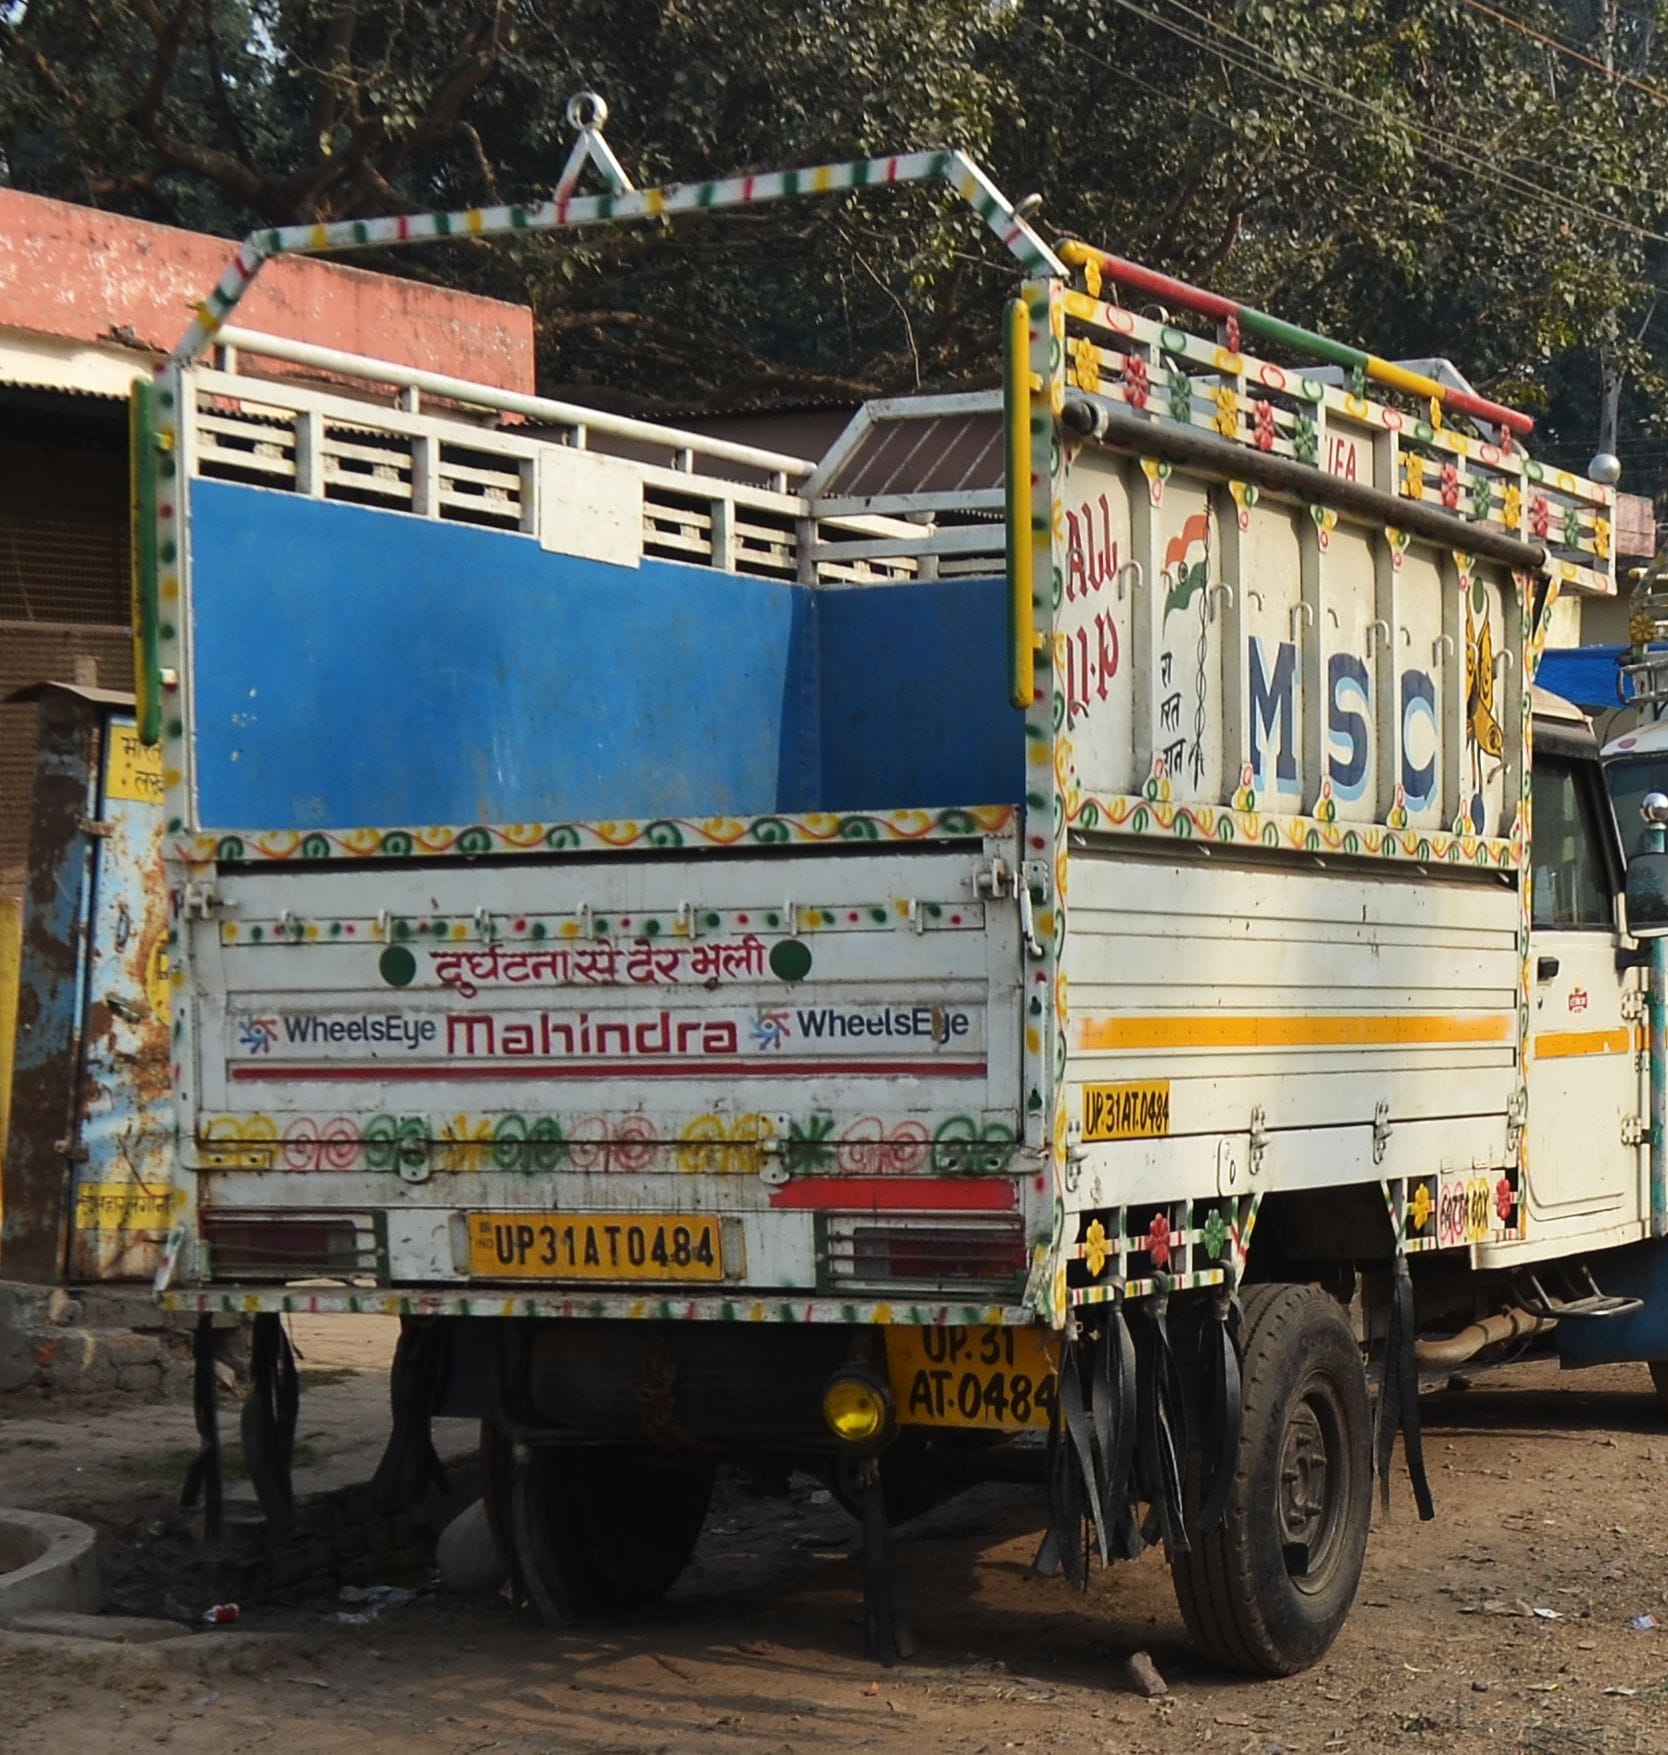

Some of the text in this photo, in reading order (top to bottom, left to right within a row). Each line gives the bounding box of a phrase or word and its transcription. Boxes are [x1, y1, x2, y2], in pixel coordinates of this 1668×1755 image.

[690, 932, 767, 980] भली
[283, 1013, 437, 1050] WheelsEye
[494, 1224, 715, 1269] UP31AT0484
